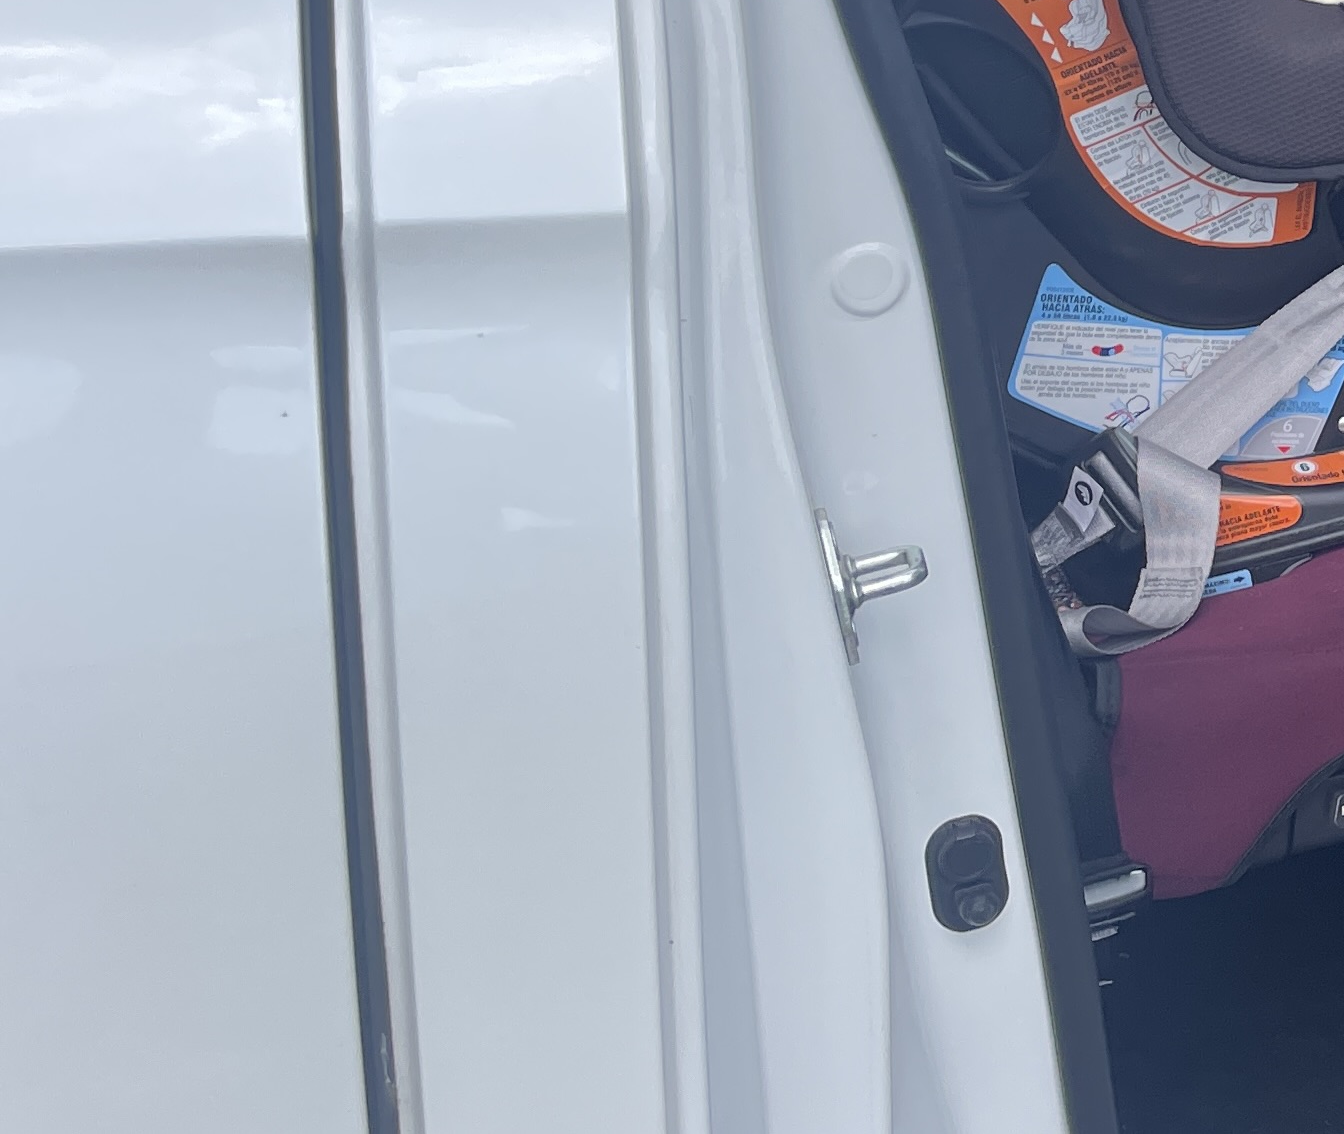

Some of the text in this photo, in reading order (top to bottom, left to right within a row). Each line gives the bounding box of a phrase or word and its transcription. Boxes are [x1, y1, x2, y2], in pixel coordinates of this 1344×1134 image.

[1061, 46, 1127, 78] ORIENTADO HACIA
[1080, 61, 1118, 80] ADELANTE
[1040, 292, 1093, 304] ORIENTADO
[1041, 302, 1105, 314] HACIA ATRÁS:
[1283, 419, 1292, 432] 6
[1300, 462, 1310, 472] 6
[1292, 471, 1340, 483] Orientado
[1244, 506, 1280, 520] ADELANTE
